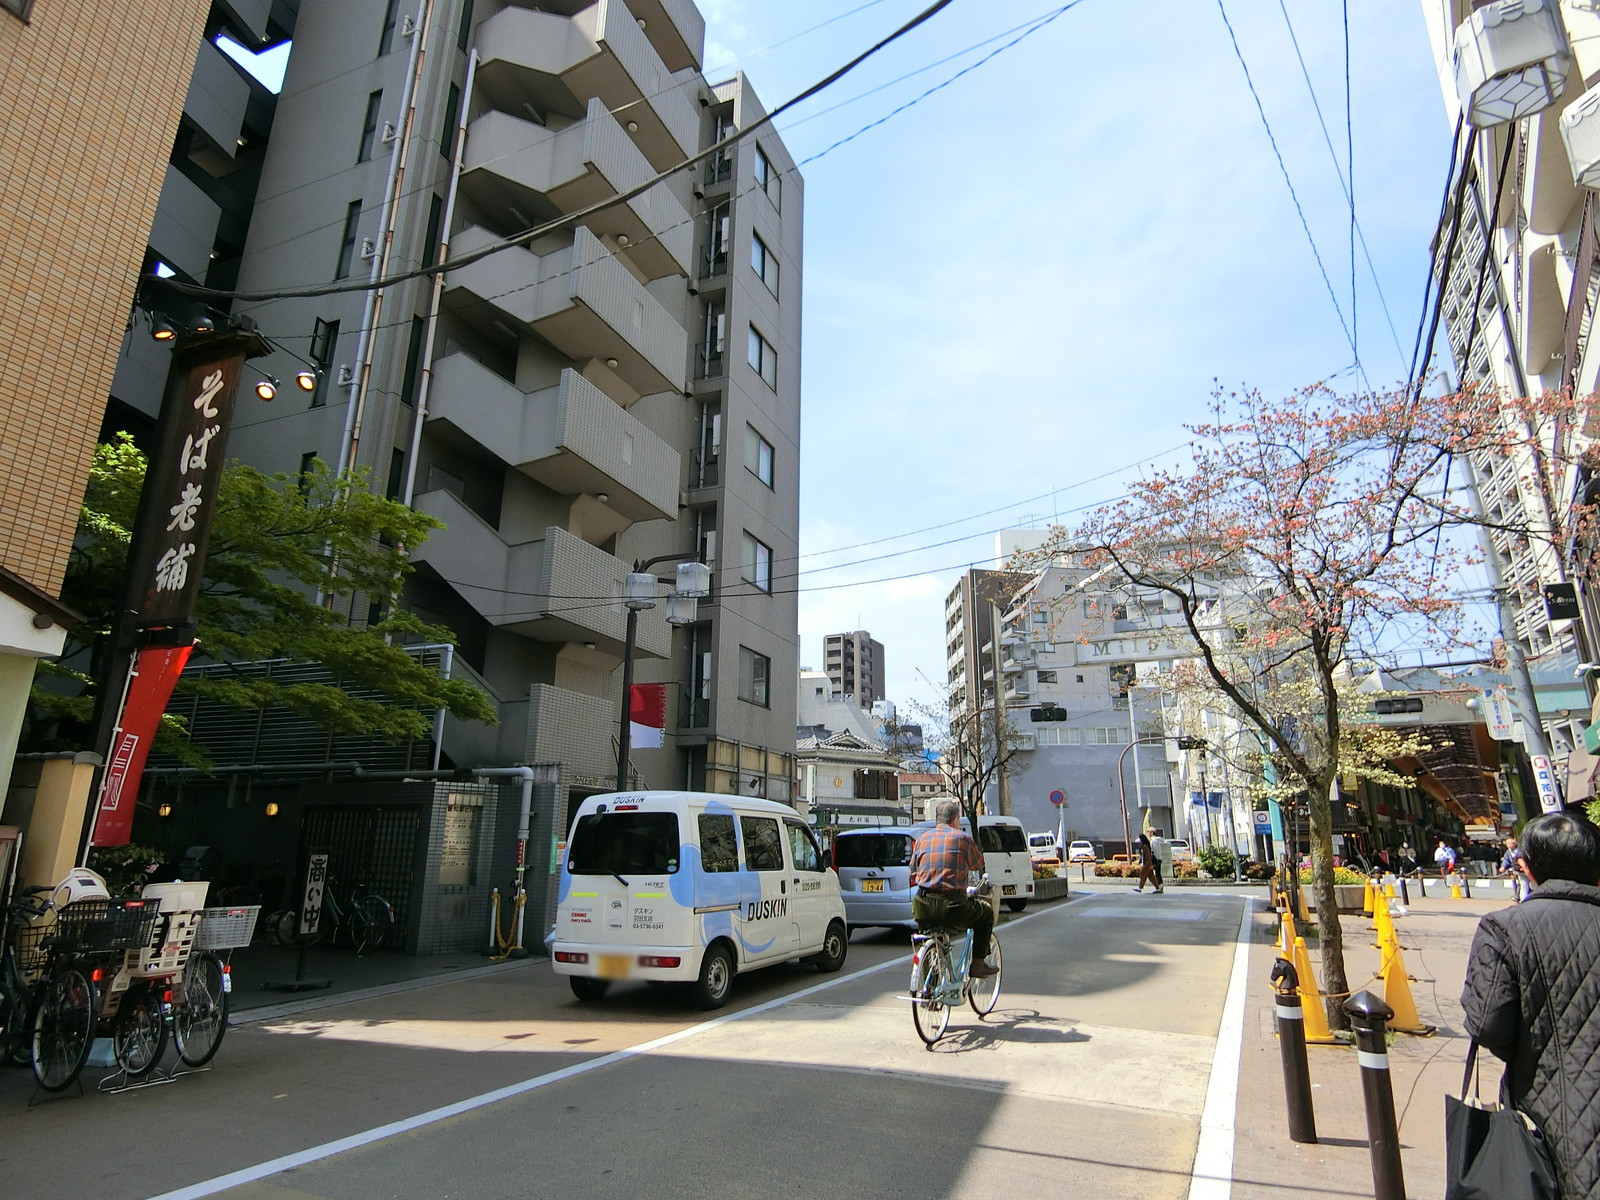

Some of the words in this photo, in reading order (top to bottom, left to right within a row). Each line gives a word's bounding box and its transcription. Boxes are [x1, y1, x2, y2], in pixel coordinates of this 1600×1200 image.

[156, 369, 224, 592] そば老舗
[304, 856, 327, 932] 商い中
